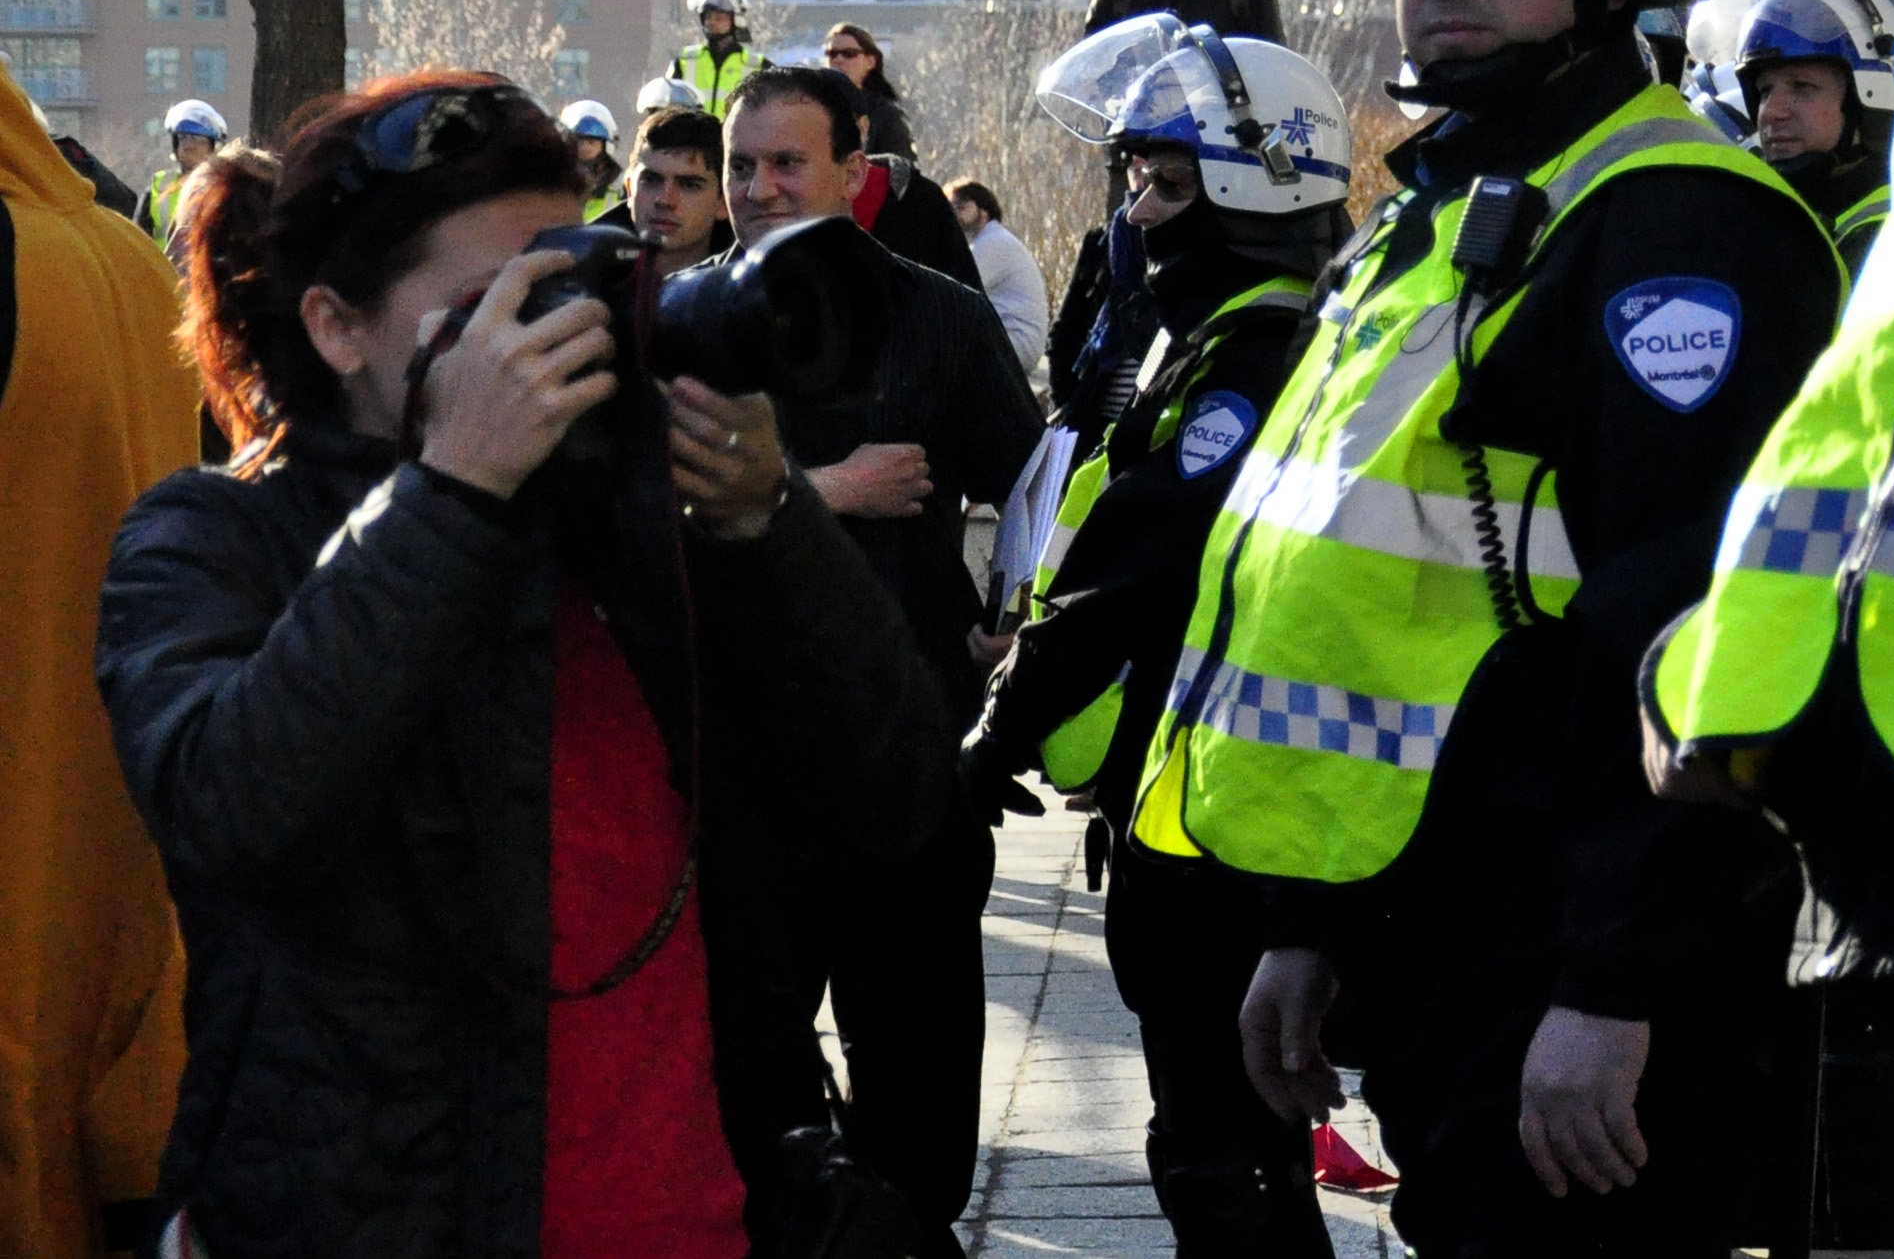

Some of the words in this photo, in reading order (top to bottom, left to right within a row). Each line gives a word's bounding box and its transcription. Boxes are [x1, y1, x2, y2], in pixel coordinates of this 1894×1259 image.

[1305, 109, 1338, 129] Police
[1629, 329, 1726, 356] POLICE
[1185, 425, 1235, 448] POLICE
